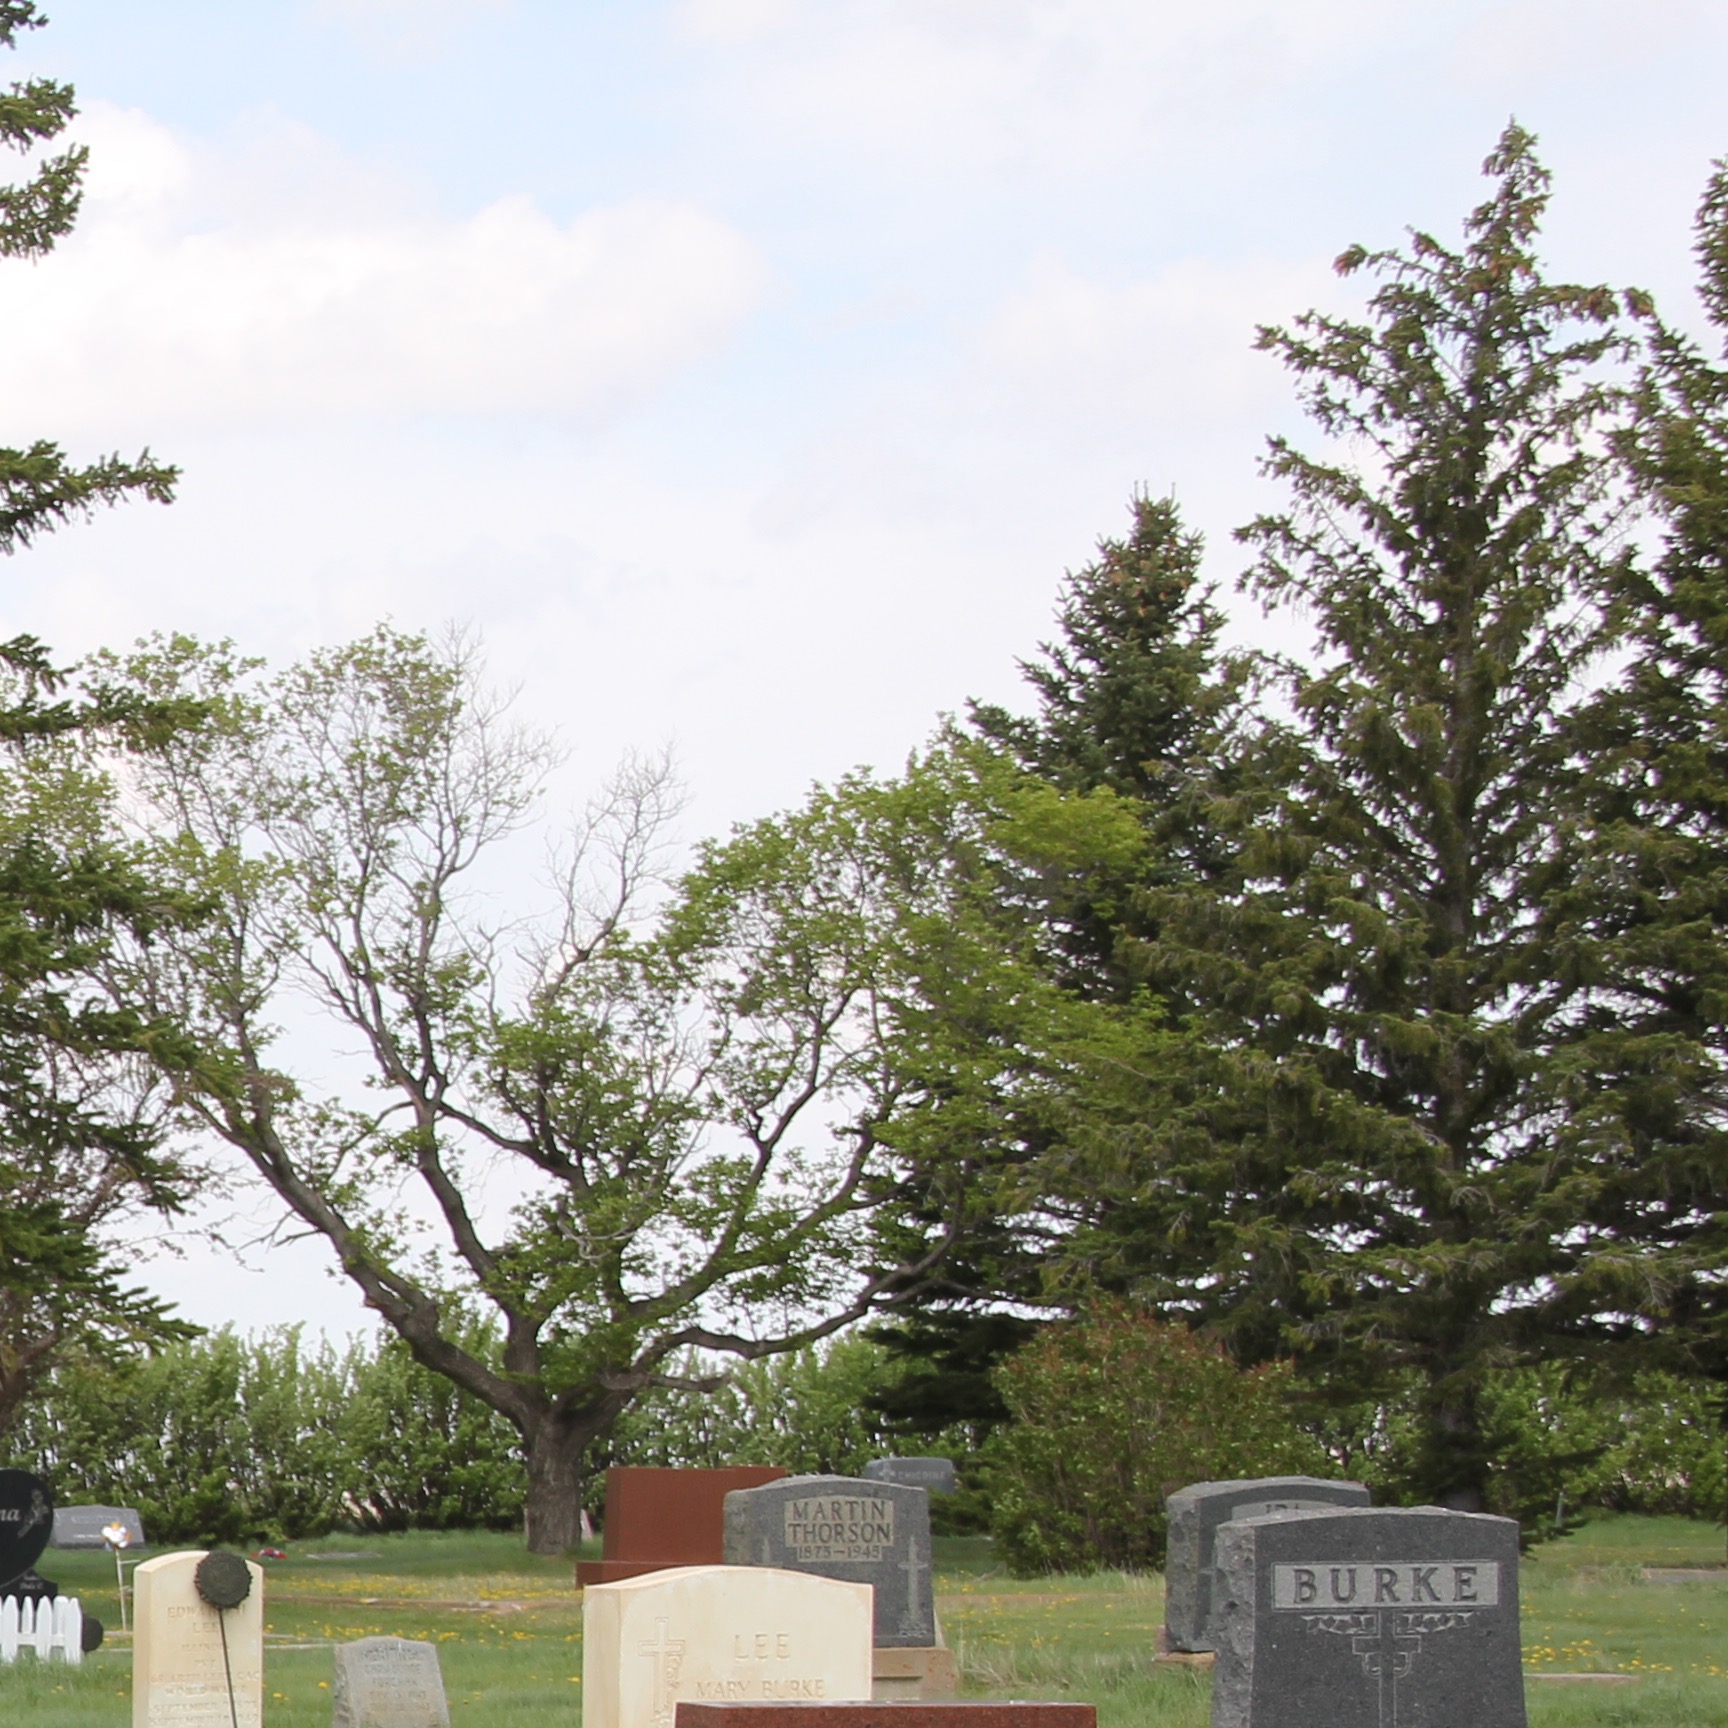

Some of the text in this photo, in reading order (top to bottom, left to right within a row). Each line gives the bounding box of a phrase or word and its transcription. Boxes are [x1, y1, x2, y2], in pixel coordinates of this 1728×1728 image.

[793, 1501, 885, 1520] MARTIN
[788, 1523, 890, 1543] THORSON
[1292, 1566, 1478, 1604] BURKE
[734, 1633, 791, 1660] LEE
[696, 1679, 825, 1700] MARY BURKE
